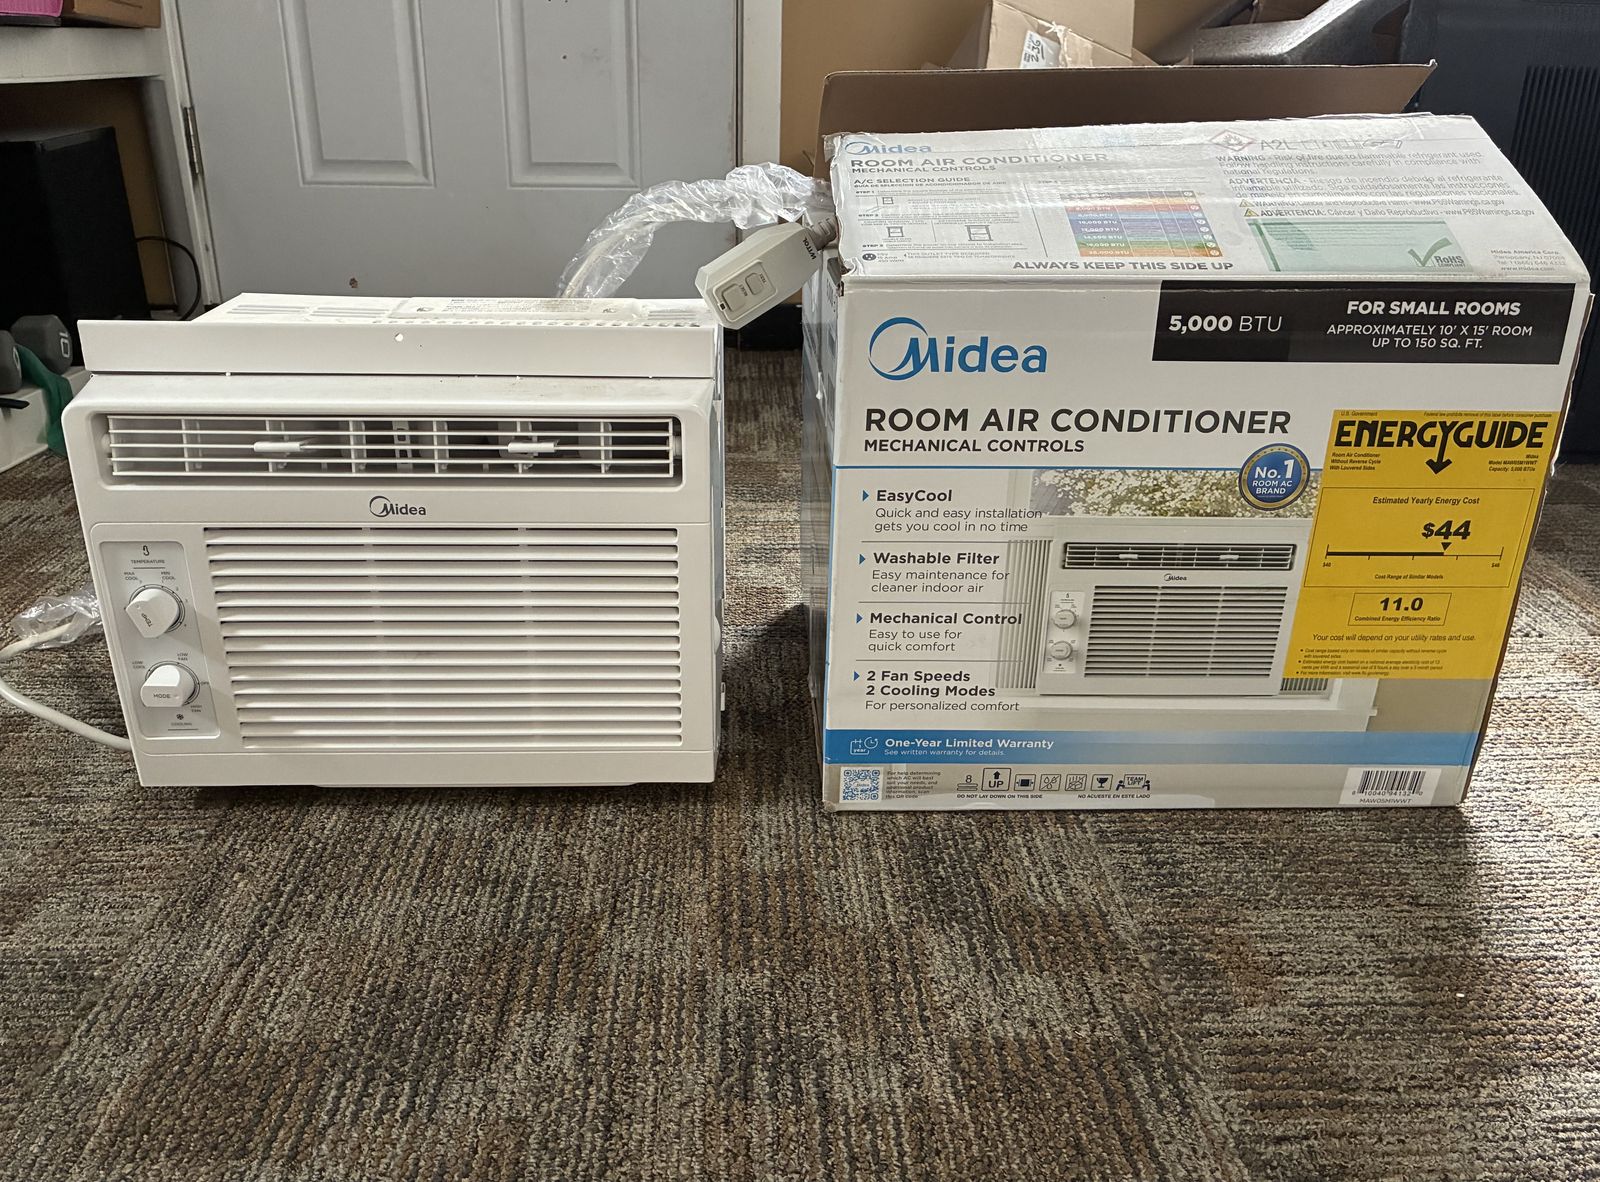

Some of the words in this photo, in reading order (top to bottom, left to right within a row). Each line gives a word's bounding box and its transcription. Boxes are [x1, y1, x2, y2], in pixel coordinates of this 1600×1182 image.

[845, 141, 931, 155] Midea
[851, 159, 913, 167] ROOM
[921, 158, 955, 166] AIR
[963, 154, 1109, 165] CONDITIONER
[1083, 262, 1125, 270] KEEP
[1129, 262, 1167, 270] THIS
[1170, 262, 1208, 270] SIDE
[1211, 262, 1233, 270] UP
[1347, 301, 1385, 314] FOR
[1389, 301, 1449, 315] SMALL
[1454, 302, 1521, 316] ROOMS
[1169, 315, 1233, 333] 5,000
[1238, 316, 1282, 332] BTU
[1327, 325, 1436, 336] APPROXIMATELY
[1439, 325, 1456, 336] 10'
[1460, 326, 1469, 336] X
[1473, 325, 1489, 336] 15'
[1492, 326, 1532, 336] ROOM
[868, 316, 1048, 381] Midea
[1372, 338, 1390, 348] UP
[1393, 338, 1412, 348] TO
[1415, 338, 1437, 348] 150
[1440, 338, 1461, 349] SQ.
[1465, 338, 1483, 348] FT.
[865, 408, 968, 432] ROOM
[980, 408, 1038, 432] AIR
[1051, 408, 1290, 434] CONDITIONER
[1334, 420, 1549, 448] ENERGYGUIDE
[864, 439, 981, 452] MECHANICAL
[987, 439, 1084, 452] CONTROLS
[1254, 466, 1281, 479] No.
[1284, 459, 1295, 479] 1
[876, 490, 952, 503] EasyCool
[1411, 497, 1433, 505] Yearly
[1435, 497, 1461, 505] Energy
[369, 496, 427, 518] Midea
[875, 508, 911, 518] Quick
[915, 508, 939, 518] and
[943, 510, 971, 520] easy
[975, 508, 1042, 518] installation
[874, 522, 902, 532] gets
[906, 523, 929, 532] you
[933, 522, 960, 532] cool
[965, 522, 976, 532] in
[980, 524, 996, 532] no
[1000, 522, 1028, 532] time
[1422, 520, 1472, 540] $44
[873, 552, 951, 564] Washable
[956, 553, 999, 564] Filter
[872, 570, 902, 581] Easy
[905, 570, 987, 580] maintenance
[991, 570, 1010, 580] for
[871, 583, 917, 592] cleaner
[921, 583, 963, 592] indoor
[968, 584, 984, 593] air
[1380, 597, 1424, 611] 11.0
[870, 613, 957, 624] Mechanical
[963, 613, 1022, 624] Control
[869, 630, 898, 641] Easy
[902, 631, 915, 639] to
[944, 630, 962, 639] for
[1357, 634, 1383, 642] depend
[1410, 634, 1428, 642] utility
[868, 642, 901, 652] quick
[905, 642, 955, 651] comfort
[867, 671, 876, 681] 2
[881, 671, 909, 681] Fan
[914, 670, 970, 683] Speeds
[866, 686, 875, 696] 2
[880, 685, 939, 697] Cooling
[945, 685, 995, 696] Modes
[865, 701, 886, 710] For
[890, 701, 967, 711] personalized
[970, 701, 1020, 711] comfort
[885, 738, 942, 748] One-Year
[946, 738, 992, 748] Limited
[995, 738, 1054, 750] Warranty
[966, 775, 972, 783] 8
